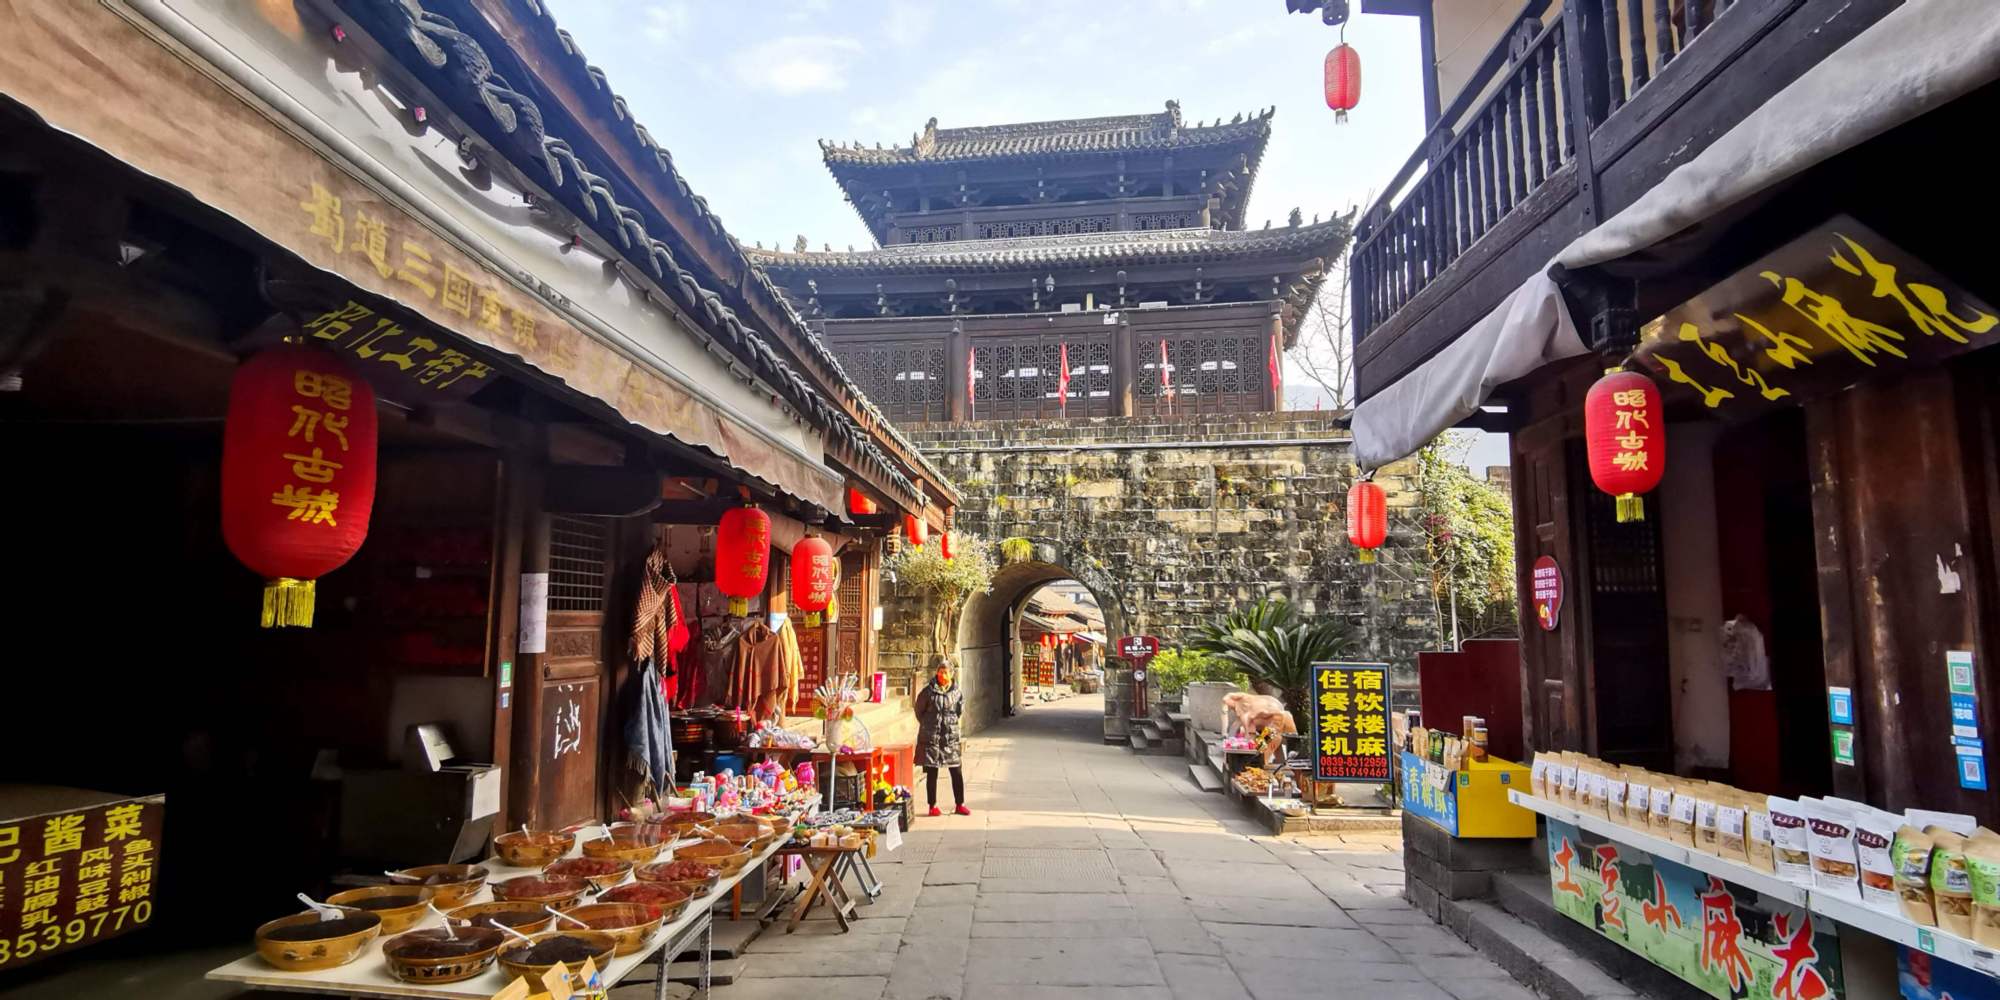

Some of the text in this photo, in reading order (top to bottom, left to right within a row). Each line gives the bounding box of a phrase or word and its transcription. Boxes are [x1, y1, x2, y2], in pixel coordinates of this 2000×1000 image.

[1612, 389, 1650, 472] 昭化古城
[271, 369, 353, 528] 昭化古城
[808, 554, 830, 604] 昭化古城
[1318, 669, 1383, 690] 住宿
[1319, 691, 1384, 712] 餐饮
[1320, 713, 1386, 735] 茶楼
[1321, 735, 1387, 757] 机麻
[1320, 756, 1388, 767] 0839-8312959
[1320, 767, 1388, 777] 13551949469
[118, 838, 154, 903] 鱼头剁椒
[21, 857, 62, 930] 红油腐乳
